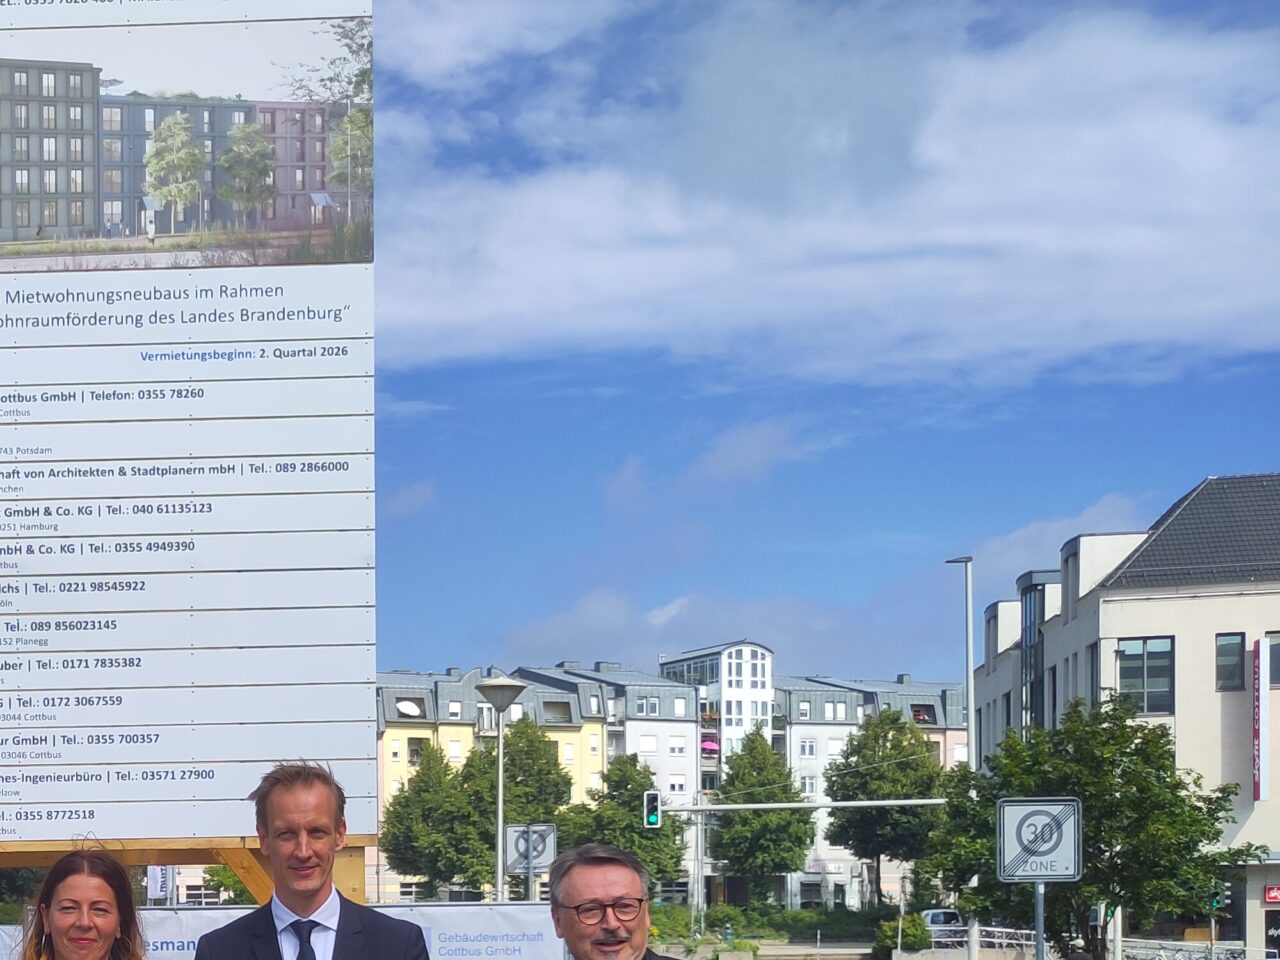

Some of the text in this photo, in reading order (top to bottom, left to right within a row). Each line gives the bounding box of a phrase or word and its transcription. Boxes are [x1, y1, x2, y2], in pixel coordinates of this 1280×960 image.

[5, 286, 190, 304] Mietwohnungsneubaus
[195, 285, 214, 299] im
[219, 283, 284, 299] Rahmen
[148, 310, 175, 325] des
[180, 309, 235, 324] Landes
[240, 304, 351, 322] Brandenburg“
[140, 346, 348, 362] Vermietungsbeginn: 2. Quartal 2026
[40, 391, 76, 402] GmbH
[89, 390, 134, 401] Telefon:
[137, 389, 166, 400] 0355
[169, 388, 204, 399] 78260
[23, 470, 45, 479] von
[47, 467, 114, 478] Architekten
[117, 466, 127, 477] &
[130, 465, 205, 477] Stadtplanern
[208, 464, 236, 474] mbH
[248, 462, 272, 474] Tel.:
[275, 462, 296, 473] 089
[299, 461, 349, 472] 2866000
[3, 506, 40, 517] GmbH
[43, 506, 53, 517] &
[55, 506, 74, 516] Co.
[77, 505, 93, 516] KG
[105, 504, 129, 515] Tel.:
[132, 504, 154, 515] 040
[156, 502, 212, 514] 61135123
[18, 522, 58, 532] Hamburg
[25, 544, 35, 555] &
[38, 544, 56, 555] Co.
[59, 543, 75, 554] KG
[88, 542, 111, 553] Tel.:
[114, 542, 142, 553] 0355
[145, 541, 195, 552] 4949390
[32, 582, 56, 593] Tel.:
[58, 582, 87, 593] 0221
[89, 581, 146, 592] 98545922
[3, 620, 27, 632] Tel.:
[30, 621, 52, 632] 089
[54, 620, 117, 631] 856023145
[15, 637, 48, 648] Planegg
[35, 659, 59, 670] Tel.:
[62, 658, 90, 669] 0171
[93, 657, 142, 668] 7835382
[16, 697, 40, 708] Tel.:
[42, 696, 70, 707] 0172
[73, 695, 122, 706] 3067559
[12, 734, 48, 746] GmbH
[60, 734, 84, 745] Tel.:
[86, 734, 115, 745] 0355
[118, 733, 160, 744] 700357
[0, 751, 28, 760] 03046
[29, 751, 62, 759] Cottbus
[114, 770, 138, 781] Tel.:
[141, 770, 176, 781] 03571
[179, 769, 214, 780] 27900
[15, 810, 43, 821] 0355
[46, 809, 95, 820] 8772518
[1021, 860, 1057, 872] ZONE
[438, 932, 544, 942] Gebäudewirtschaft
[438, 945, 522, 956] Cottbus GmbH
